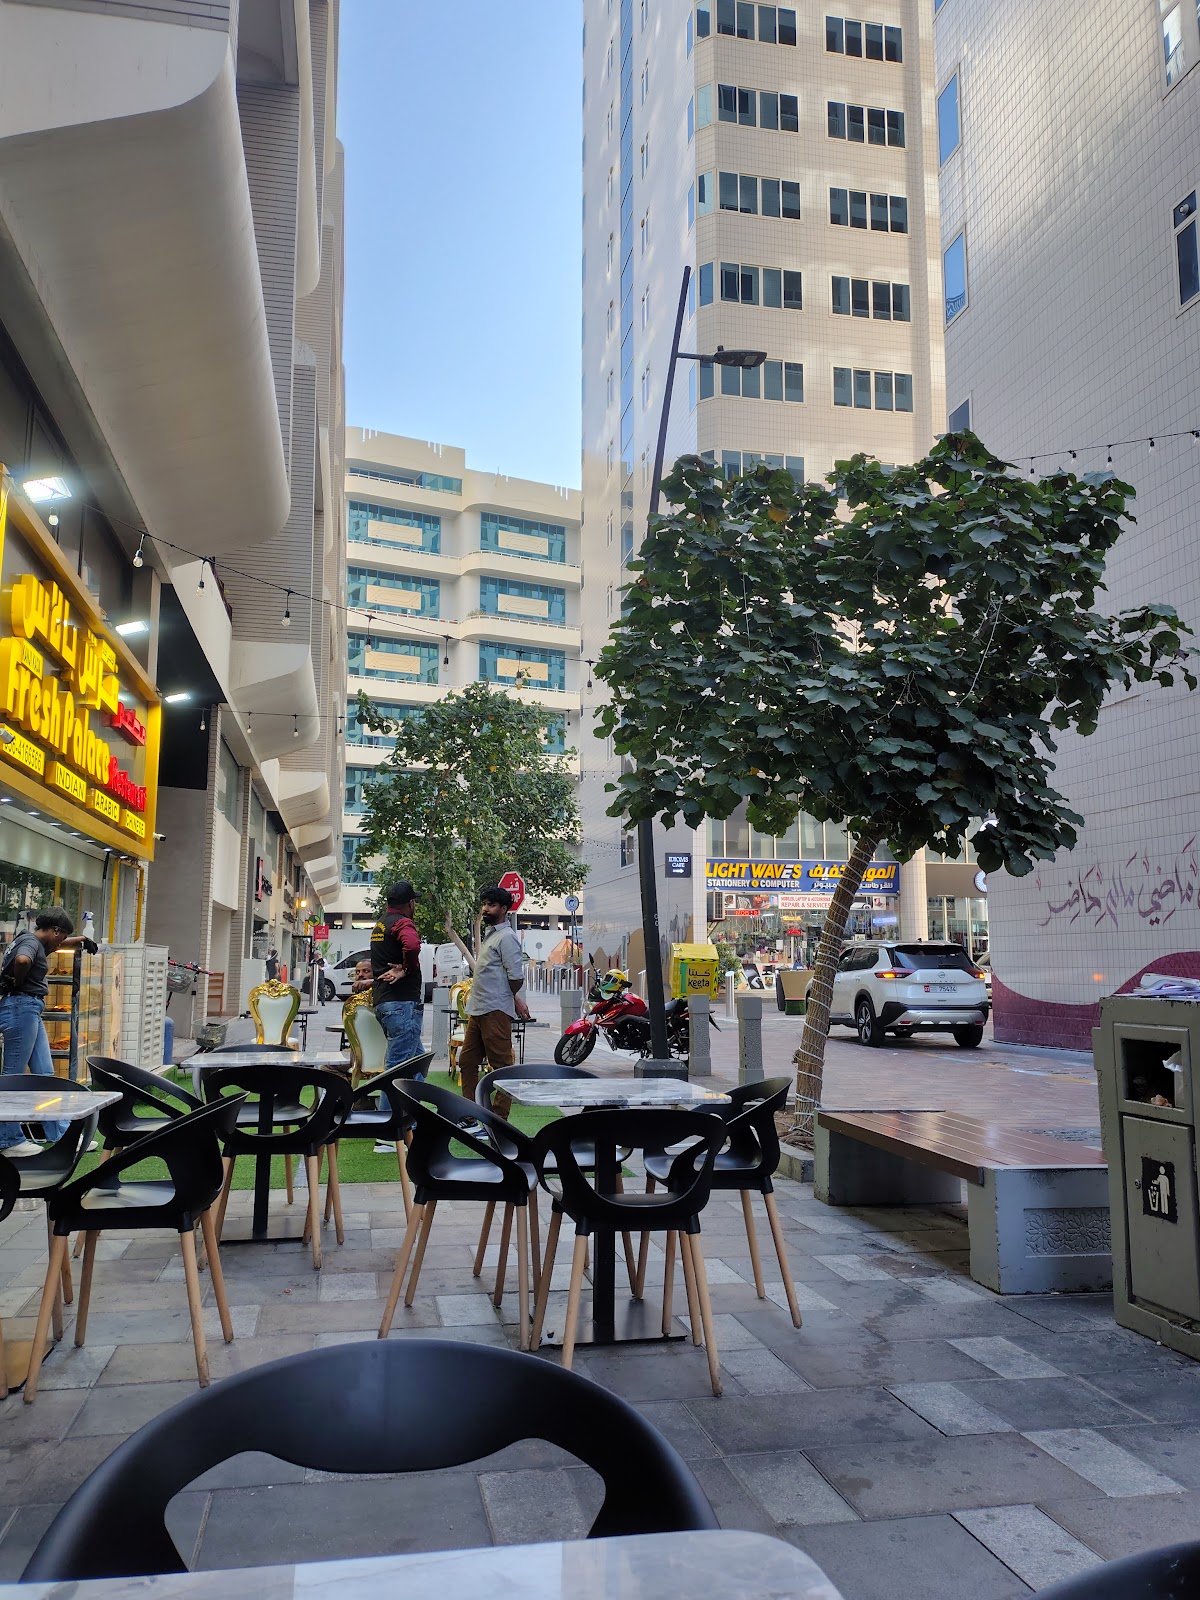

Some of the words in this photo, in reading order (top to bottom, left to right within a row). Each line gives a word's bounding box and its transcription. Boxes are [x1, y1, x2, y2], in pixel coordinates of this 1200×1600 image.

[2, 637, 61, 749] Fresh
[62, 690, 110, 785] Palace
[56, 764, 85, 801] INDIAN
[96, 792, 118, 820] ARABIC
[126, 811, 144, 837] CHINESE
[705, 862, 749, 878] LIGHT
[751, 863, 802, 879] WAVES
[707, 879, 750, 887] STATIONERY
[760, 880, 800, 888] COMPUTER
[511, 893, 521, 903] OP
[687, 978, 710, 989] keeta
